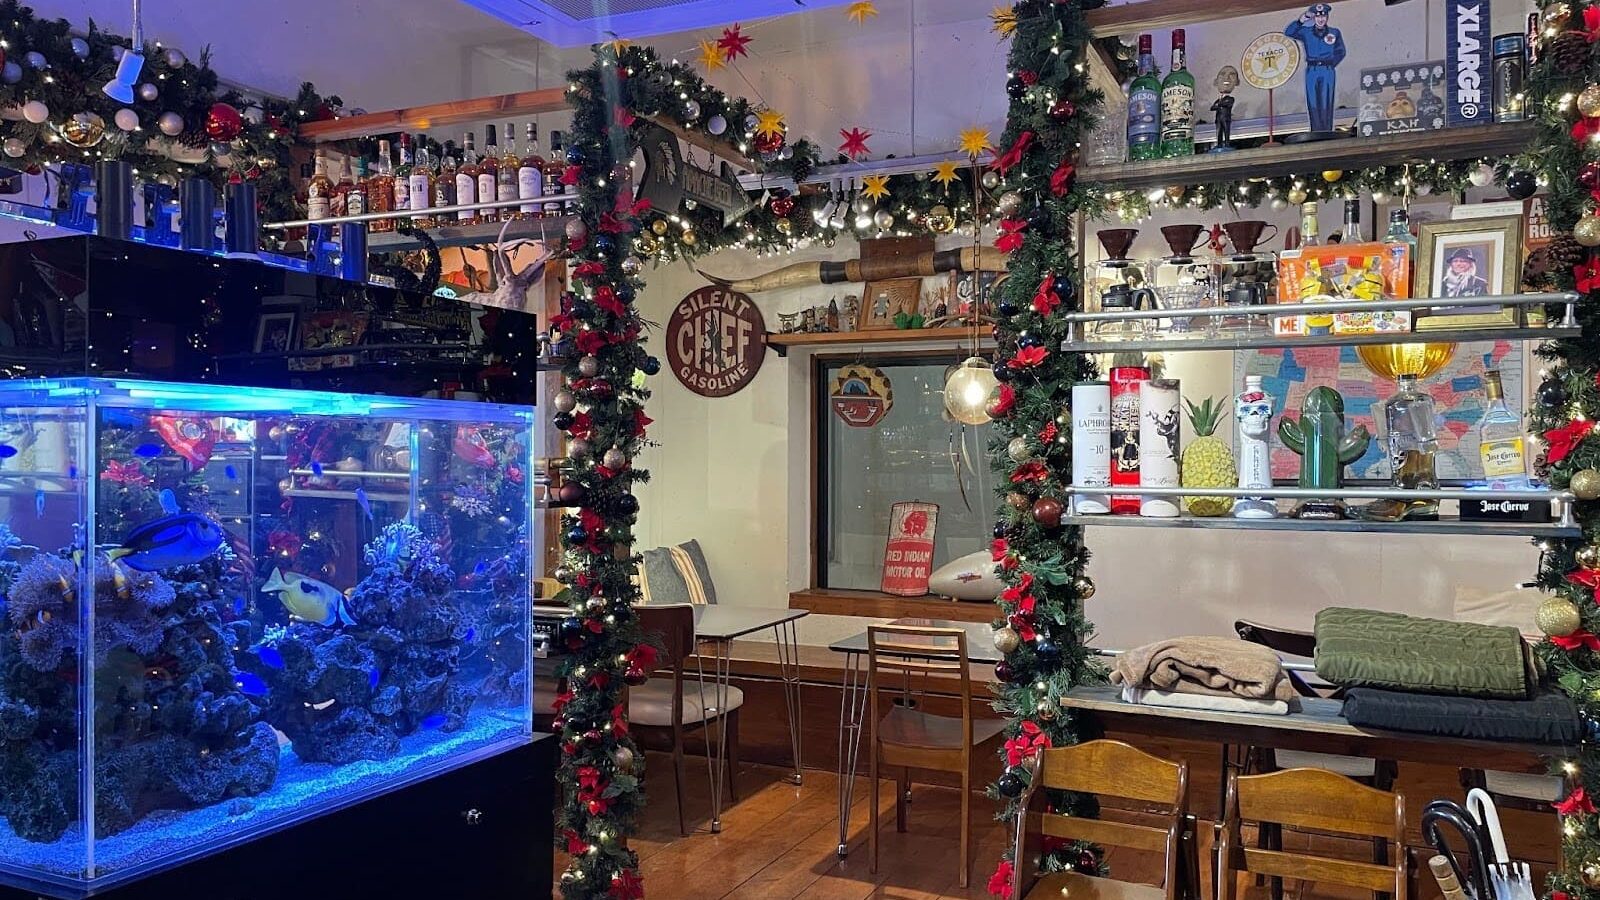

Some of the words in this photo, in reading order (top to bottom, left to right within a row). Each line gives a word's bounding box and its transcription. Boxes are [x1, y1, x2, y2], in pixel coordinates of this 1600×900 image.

[1256, 48, 1284, 57] TEXACO
[1387, 118, 1419, 130] KAH
[678, 290, 751, 320] SILENT
[1280, 316, 1298, 332] ME
[676, 308, 753, 376] CHIEF
[680, 362, 749, 390] GASOLINE
[1480, 500, 1500, 512] Jose
[1500, 500, 1530, 513] Cuervo
[886, 550, 902, 562] RED
[904, 550, 931, 563] INDIAN
[885, 566, 913, 578] MOTOR
[914, 566, 927, 579] OIL
